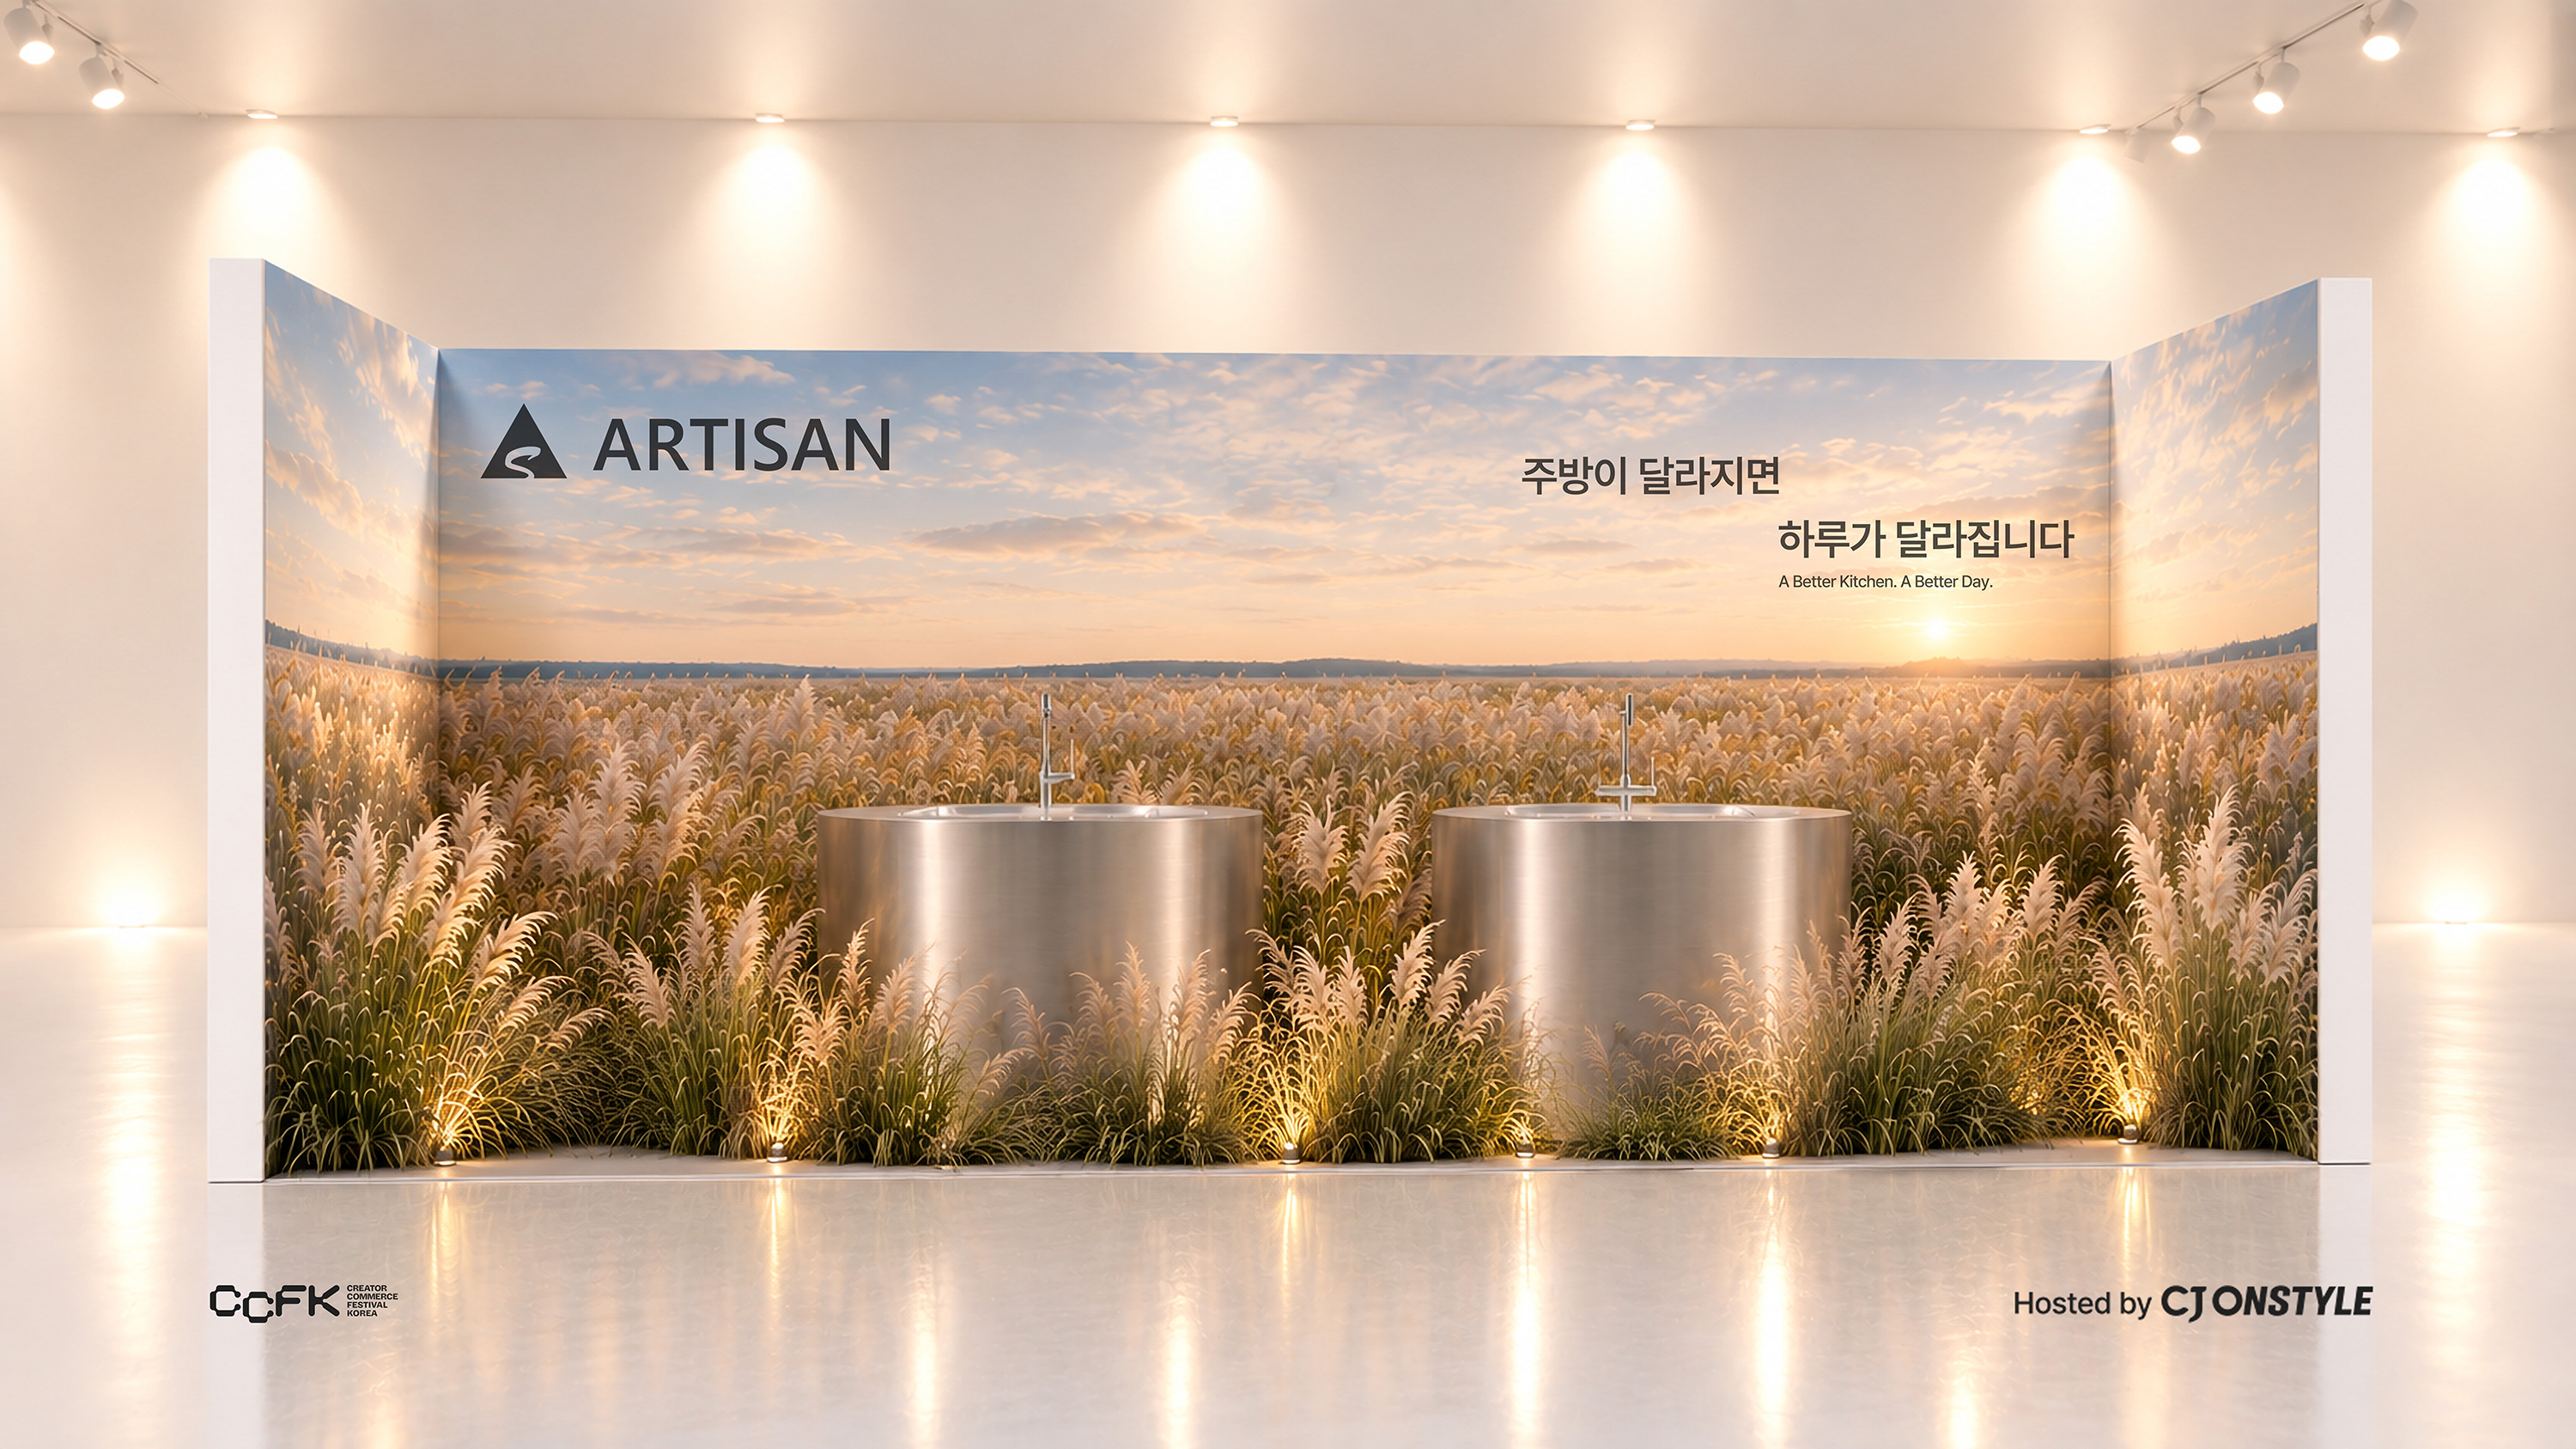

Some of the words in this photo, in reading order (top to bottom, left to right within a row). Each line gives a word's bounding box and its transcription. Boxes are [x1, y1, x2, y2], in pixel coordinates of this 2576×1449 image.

[593, 417, 890, 472] ARTISAN
[1522, 456, 1626, 496] 주방이
[1639, 456, 1780, 496] 달라지면
[1778, 520, 1886, 558] 하루가
[1896, 520, 2075, 559] 달라집니다
[1778, 575, 1789, 588] A
[1793, 575, 1837, 588] Better
[1840, 575, 1897, 588] Kitchen.
[1900, 575, 1911, 588] A
[1915, 575, 1959, 588] Better
[1962, 575, 1993, 591] Day.
